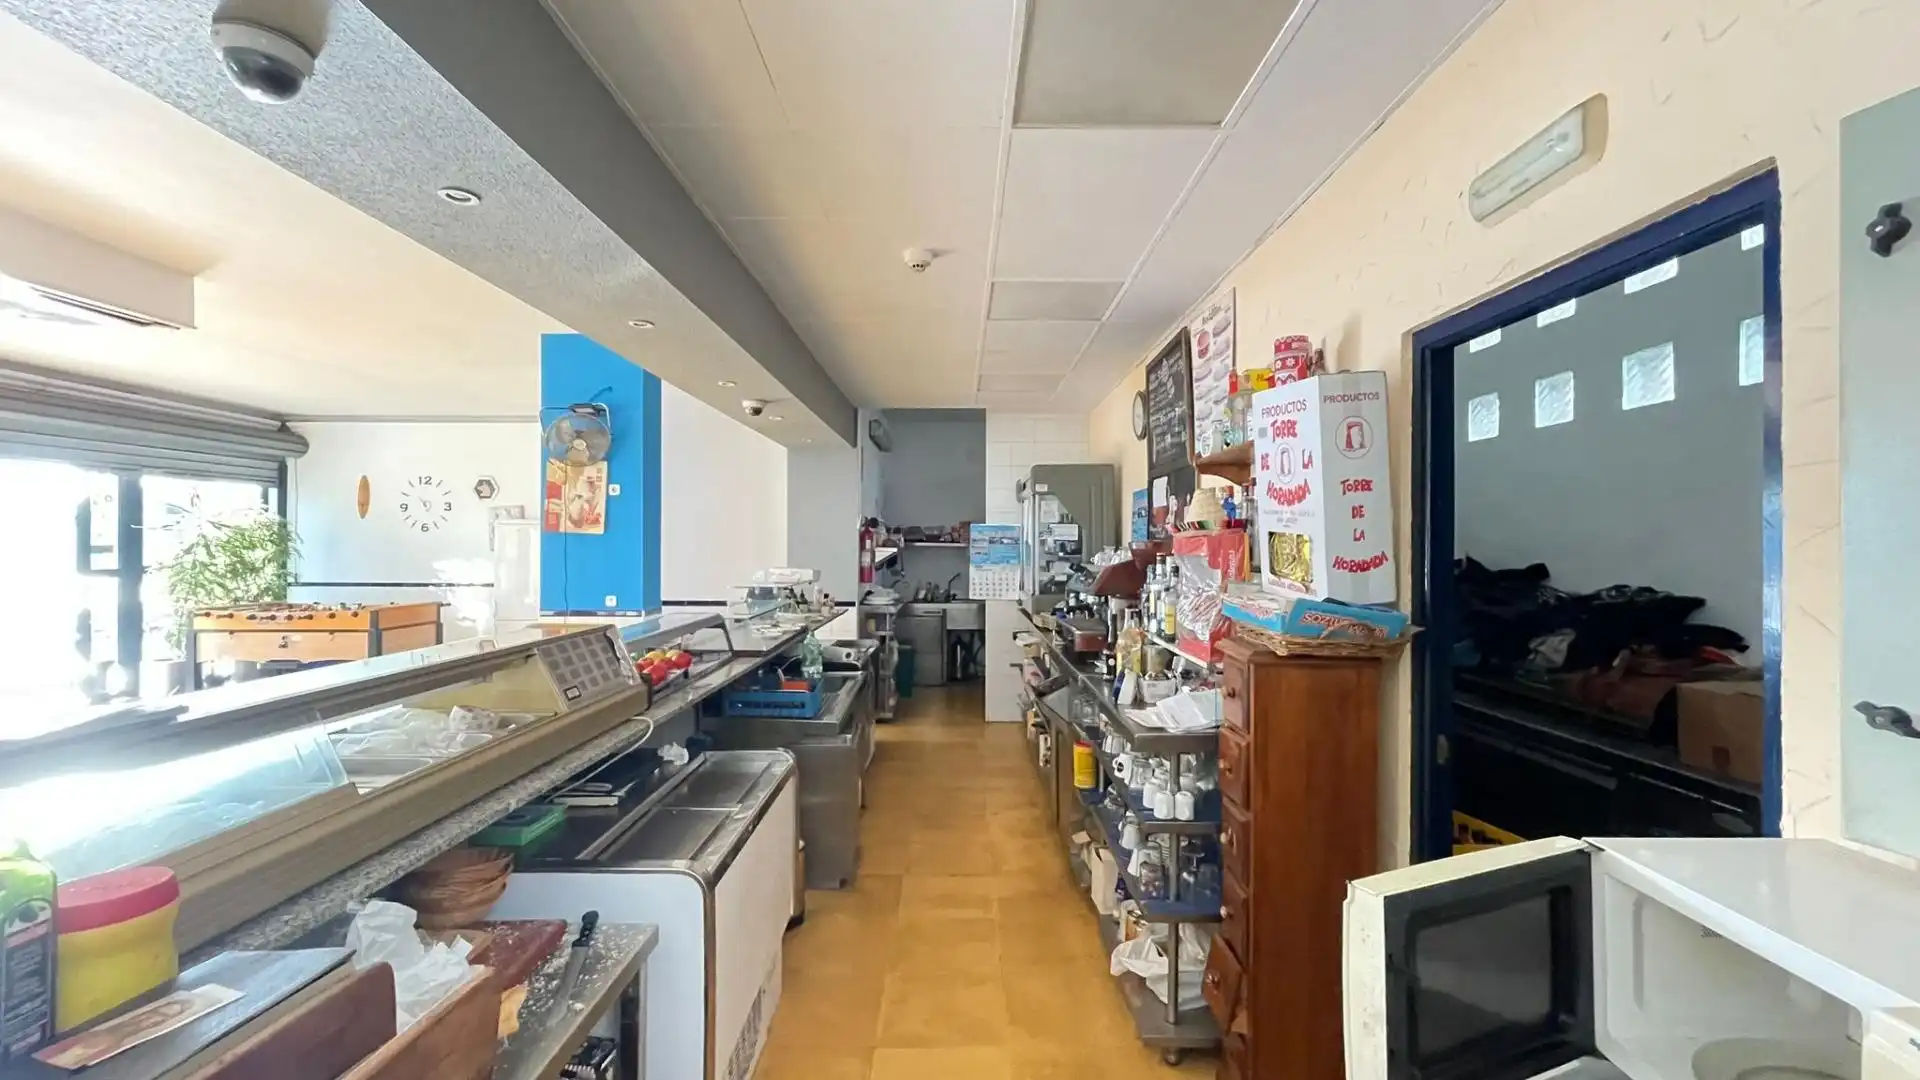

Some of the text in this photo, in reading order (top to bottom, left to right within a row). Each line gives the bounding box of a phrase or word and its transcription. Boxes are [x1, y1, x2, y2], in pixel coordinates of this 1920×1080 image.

[1323, 391, 1380, 404] PRODUCTOS
[1261, 399, 1307, 418] PRODUCTOS
[1270, 419, 1298, 442] TORRE
[1260, 449, 1313, 471] DE LA
[418, 476, 432, 485] 12
[1340, 478, 1373, 495] TORRE
[399, 503, 408, 512] 9
[444, 502, 452, 511] 3
[1351, 504, 1365, 519] DE
[420, 523, 429, 532] 6
[1353, 528, 1365, 541] LA
[1332, 551, 1389, 573] HORADADA
